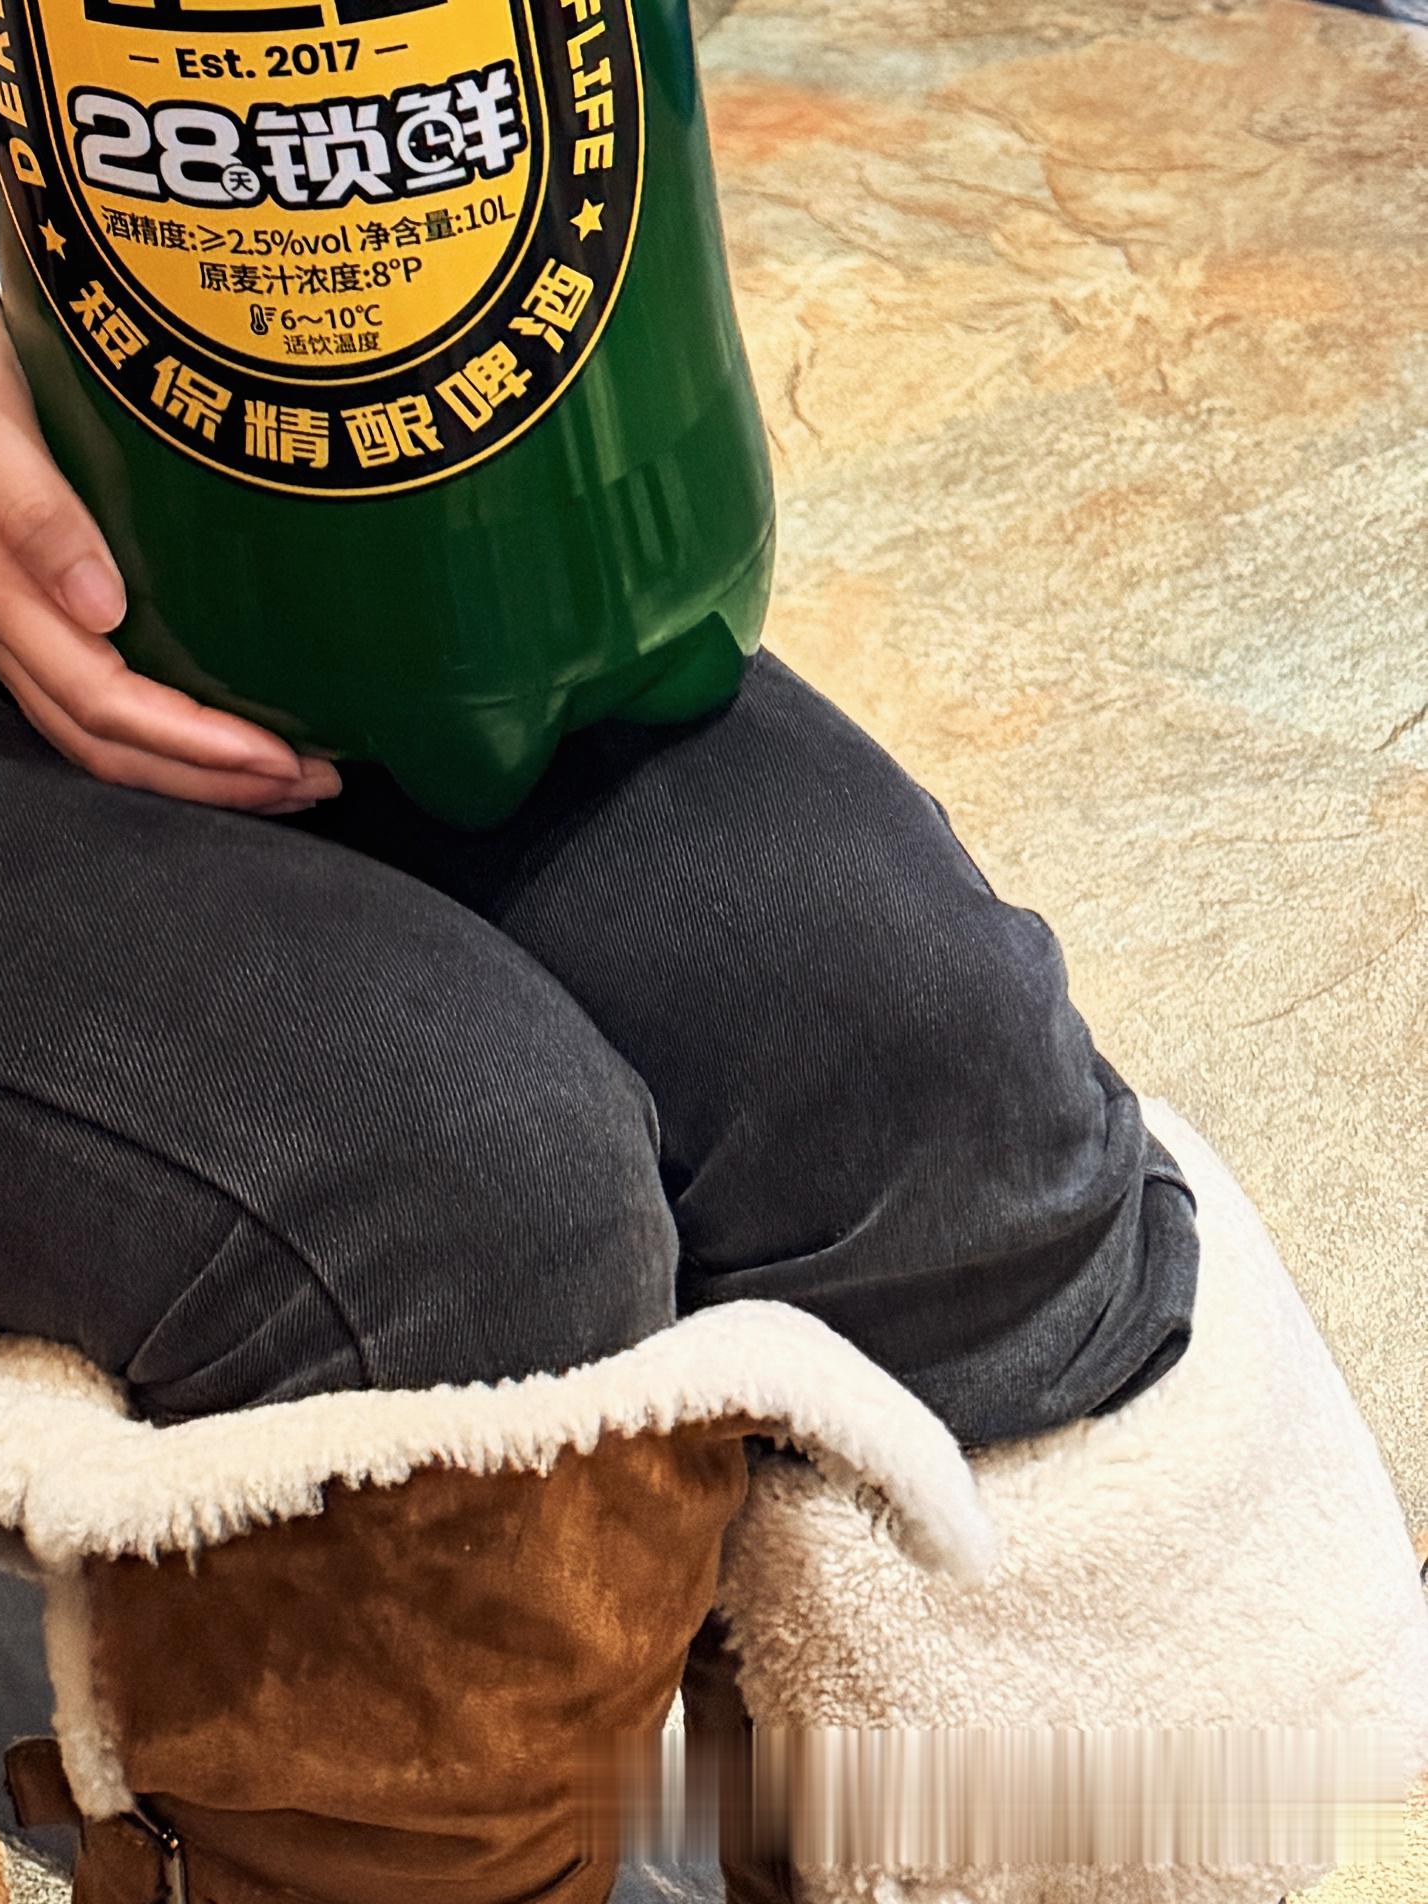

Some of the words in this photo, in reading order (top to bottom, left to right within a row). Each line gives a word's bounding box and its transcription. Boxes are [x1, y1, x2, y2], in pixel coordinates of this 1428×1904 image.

[174, 46, 258, 80] Est.
[264, 38, 361, 78] 2017
[565, 19, 615, 177] LIFE
[68, 256, 596, 470] 短保精酿啤酒
[282, 332, 382, 357] 适饮温度
